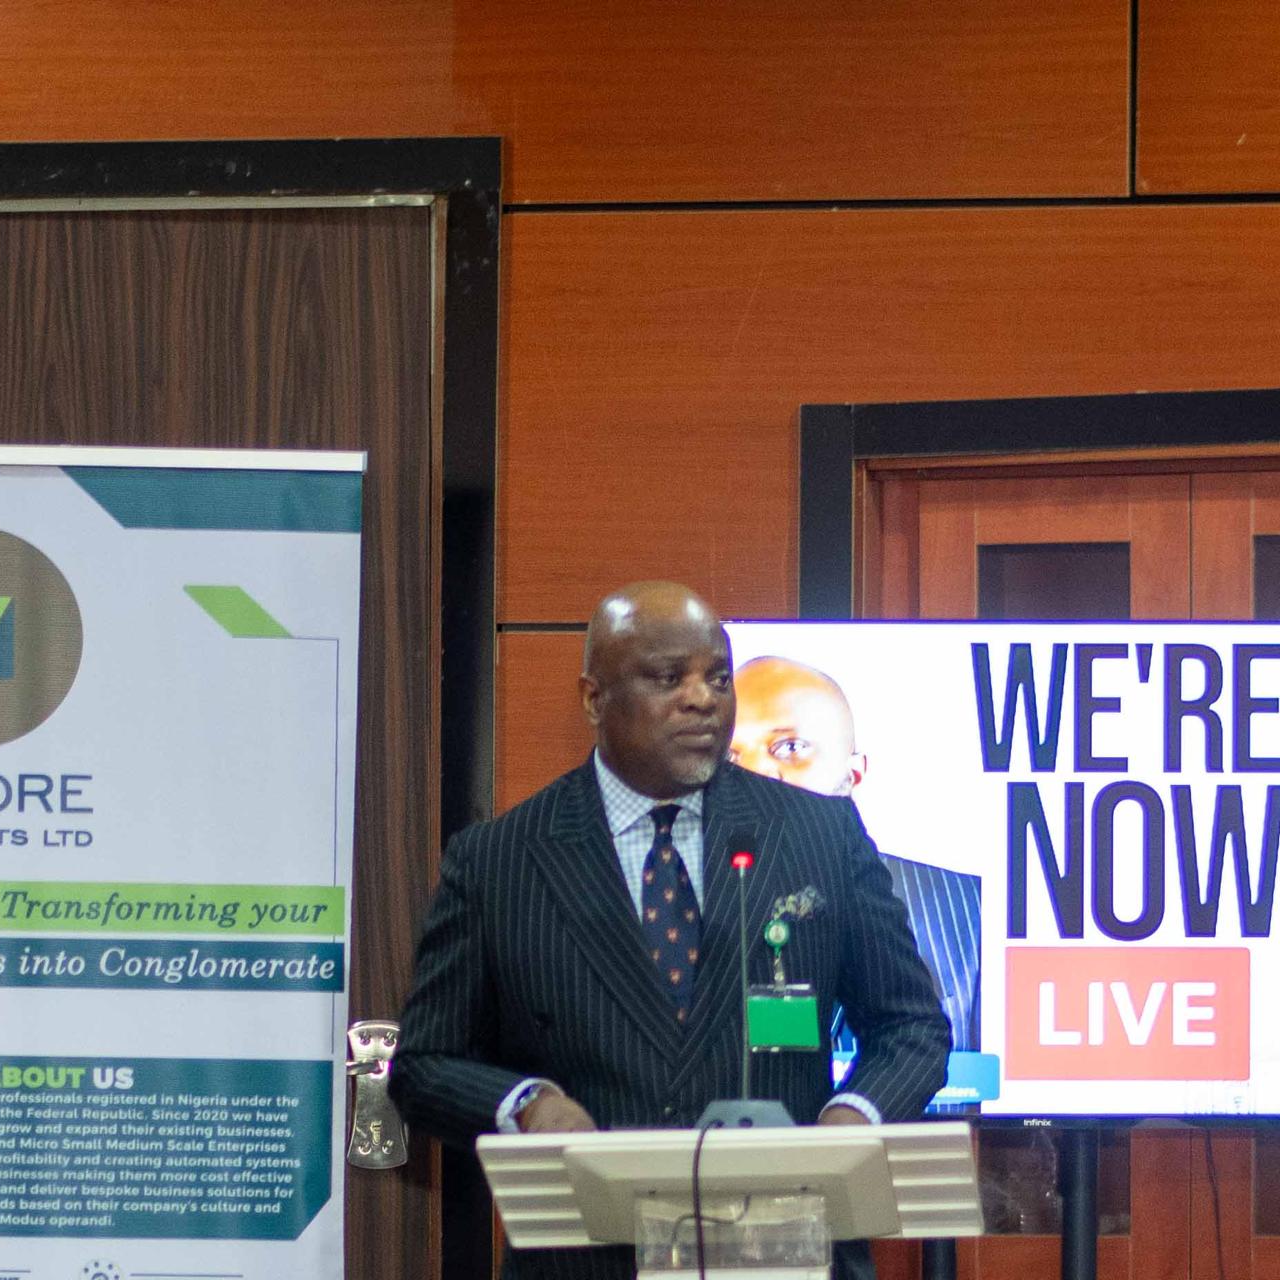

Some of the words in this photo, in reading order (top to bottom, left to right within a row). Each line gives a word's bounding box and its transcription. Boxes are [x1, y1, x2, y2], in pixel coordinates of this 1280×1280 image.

[44, 830, 93, 847] LTD
[1, 891, 239, 927] Transforming
[250, 903, 327, 928] your
[19, 949, 86, 977] into
[99, 952, 335, 981] Conglomerate
[1038, 982, 1216, 1046] LIVE
[93, 1067, 134, 1089] US
[87, 1093, 157, 1108] registered
[161, 1093, 174, 1105] in
[178, 1094, 227, 1108] Nigeria
[231, 1094, 272, 1107] under
[276, 1095, 299, 1107] the
[0, 1106, 22, 1118] the
[27, 1107, 78, 1119] Federal
[82, 1107, 147, 1122] Republic.
[151, 1108, 189, 1120] Since
[193, 1109, 228, 1121] 2020
[232, 1111, 252, 1121] we
[256, 1109, 288, 1122] have
[35, 1123, 61, 1135] and
[66, 1123, 117, 1138] expand
[121, 1124, 154, 1136] their
[158, 1124, 213, 1139] existing
[217, 1125, 294, 1138] businesses.
[20, 1137, 58, 1149] Micro
[62, 1138, 102, 1150] Small
[106, 1138, 163, 1151] Medium
[167, 1139, 204, 1151] Scale
[208, 1139, 286, 1154] Enterprises
[74, 1153, 100, 1165] and
[104, 1153, 161, 1168] creating
[166, 1154, 242, 1167] automated
[245, 1155, 300, 1170] systems
[62, 1168, 115, 1183] making
[119, 1169, 157, 1181] them
[161, 1172, 197, 1182] more
[200, 1170, 229, 1182] cost
[232, 1170, 292, 1183] effective
[0, 1183, 26, 1195] and
[30, 1183, 77, 1195] deliver
[81, 1184, 140, 1199] bespoke
[144, 1184, 203, 1197] business
[207, 1185, 270, 1198] solutions
[274, 1186, 293, 1198] for
[19, 1198, 60, 1211] based
[65, 1201, 82, 1211] on
[86, 1199, 119, 1211] their
[123, 1199, 197, 1214] company's
[200, 1200, 251, 1213] culture
[255, 1201, 281, 1213] and
[0, 1213, 45, 1226] Modus
[49, 1214, 115, 1229] operandi.
